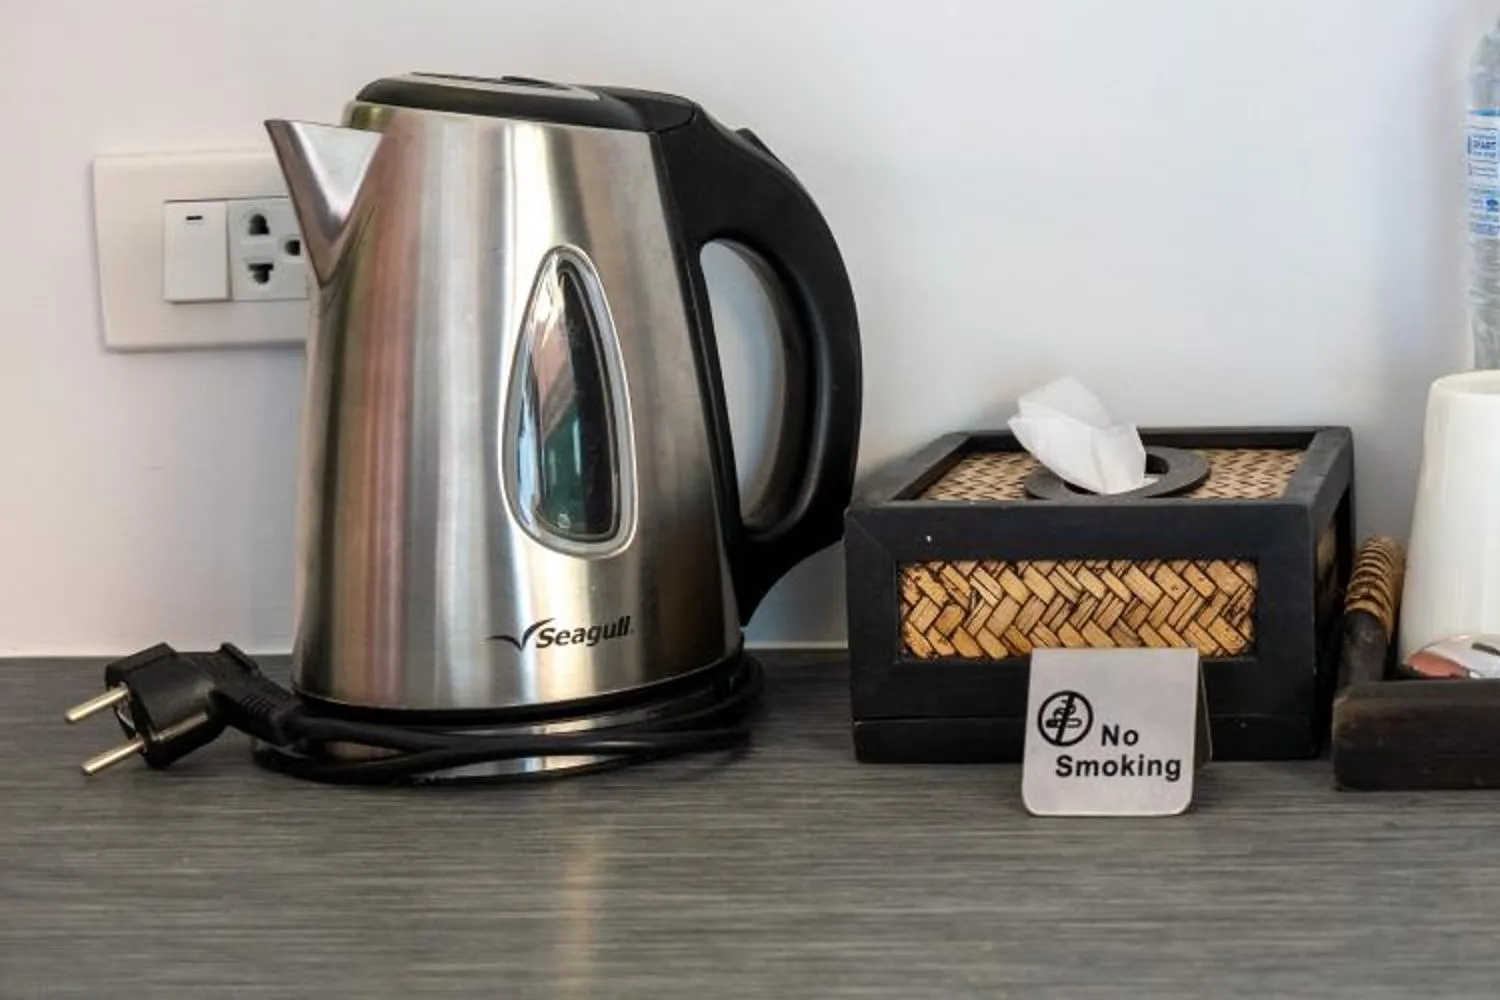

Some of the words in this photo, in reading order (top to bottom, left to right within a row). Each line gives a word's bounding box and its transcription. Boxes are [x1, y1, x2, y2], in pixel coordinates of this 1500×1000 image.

[535, 615, 631, 649] Seagull
[1101, 724, 1139, 747] No
[1055, 754, 1182, 782] Smoking
